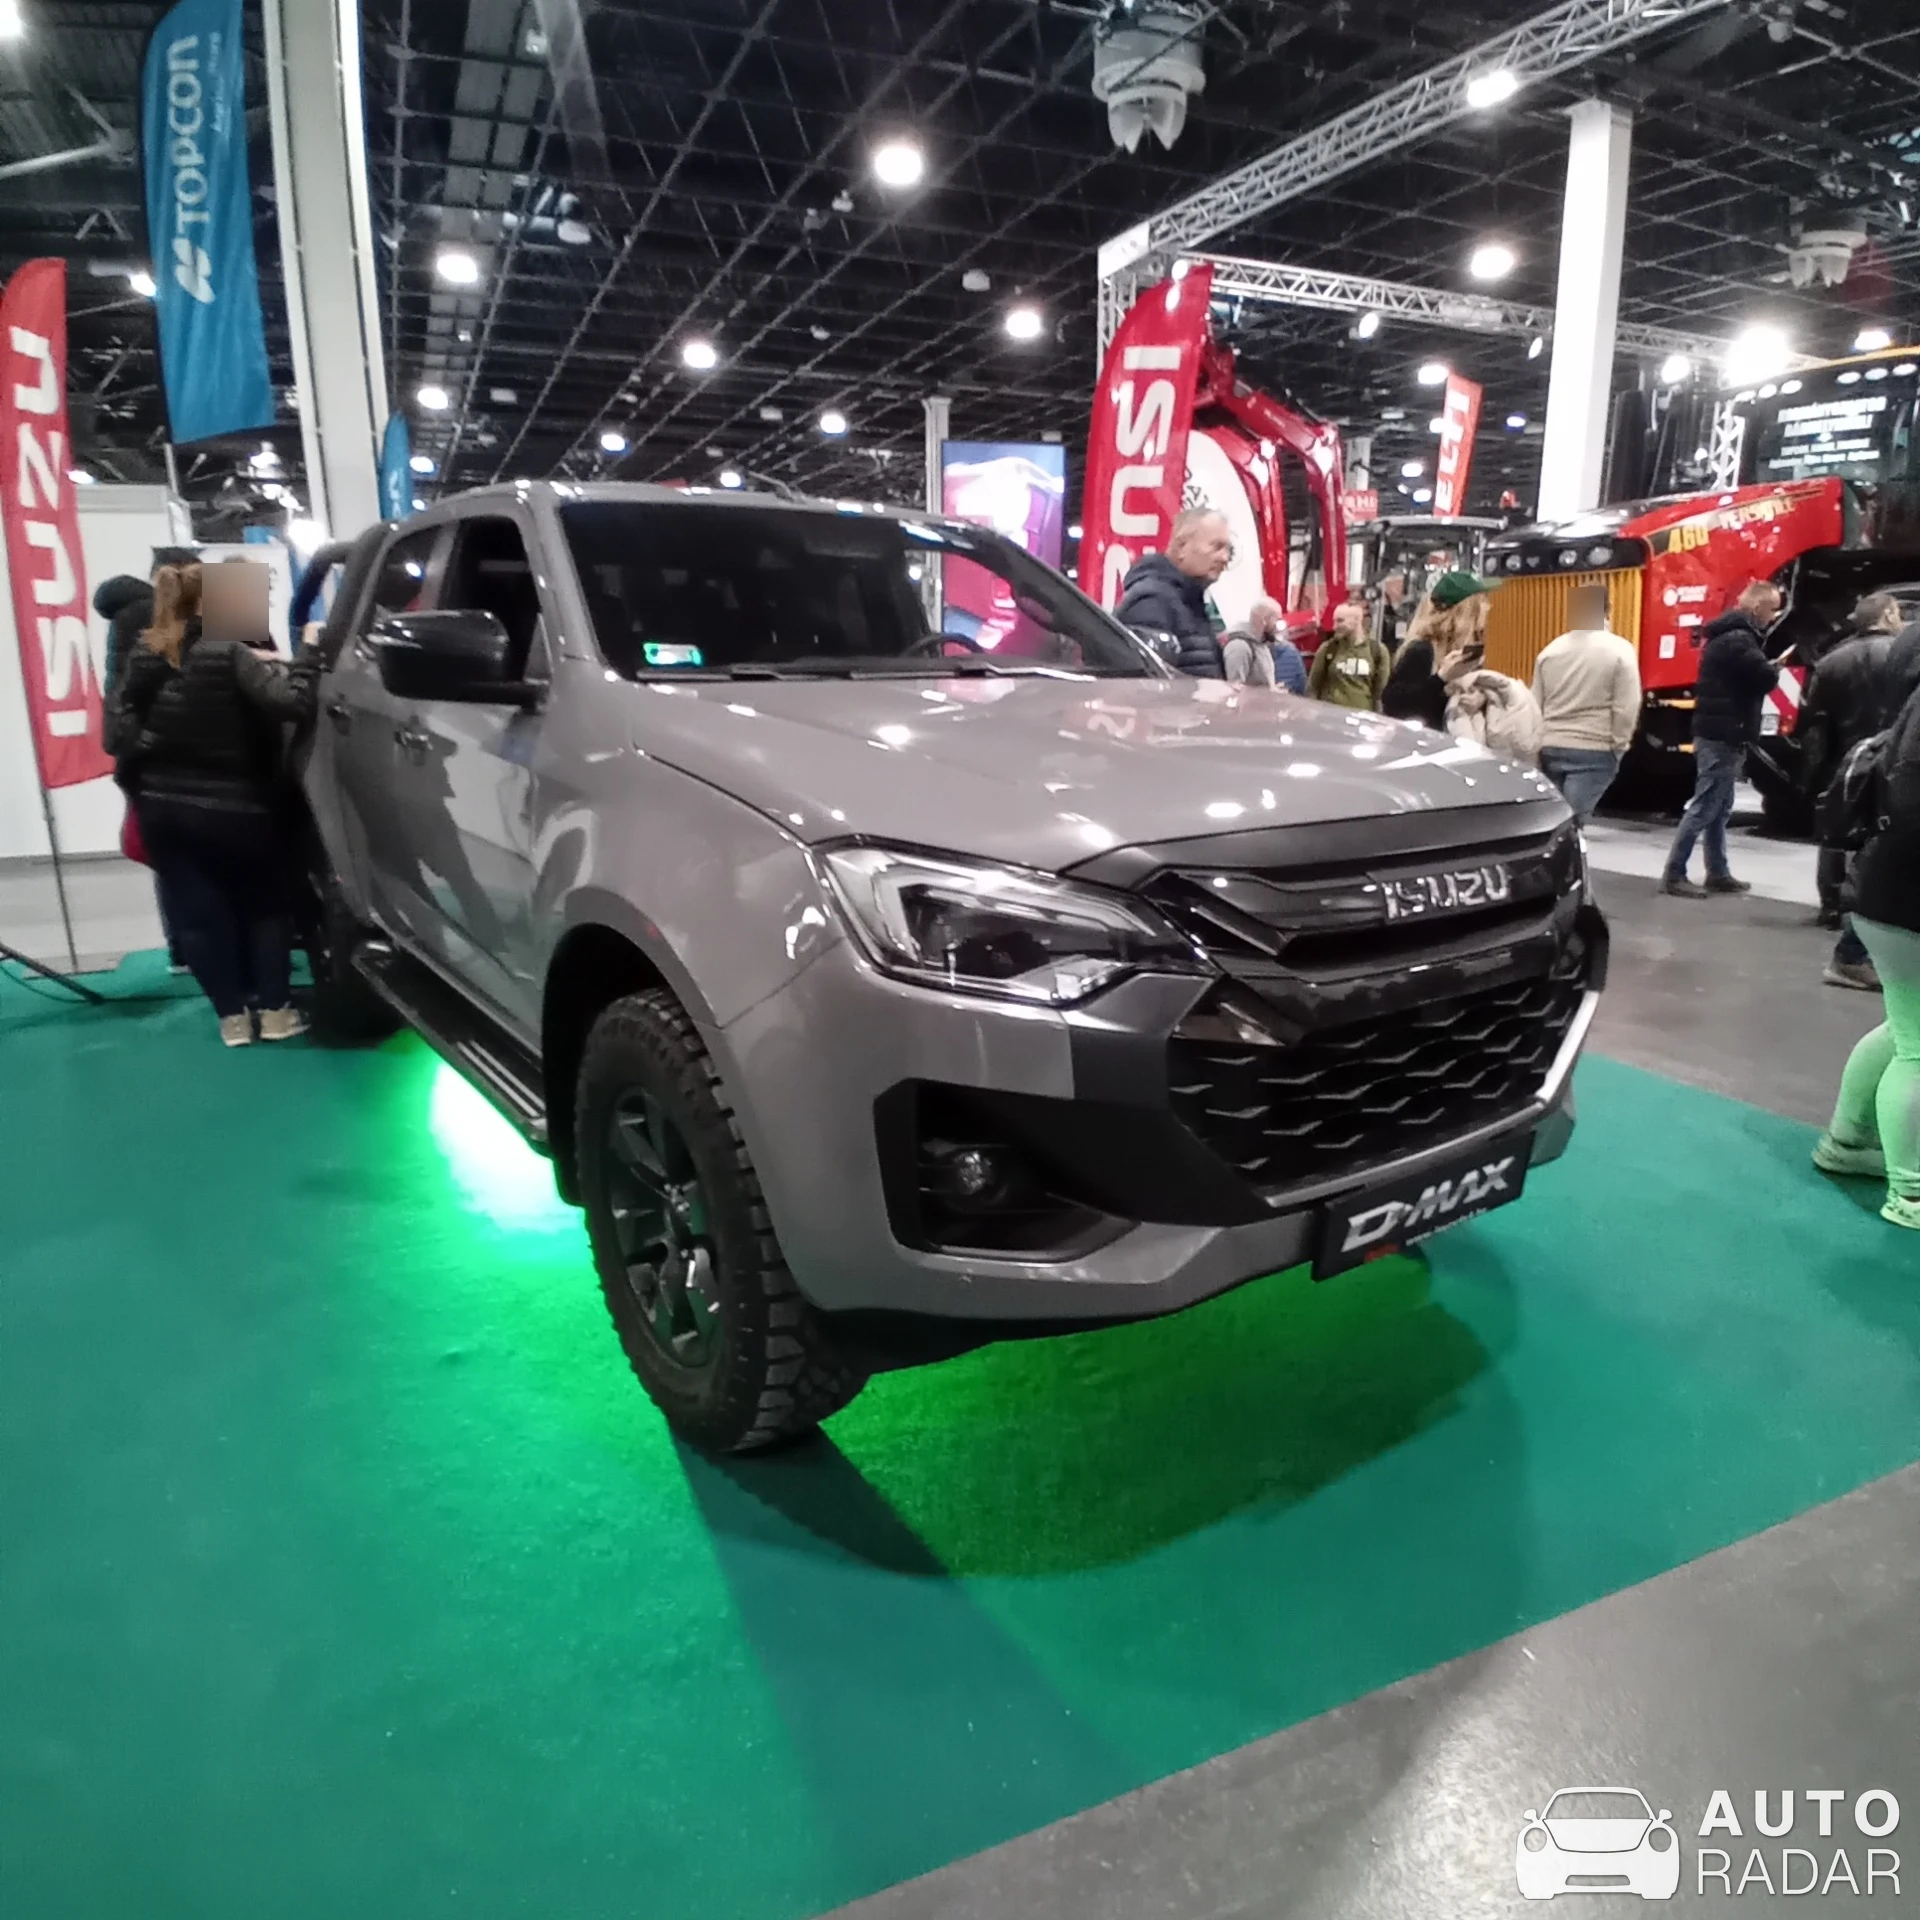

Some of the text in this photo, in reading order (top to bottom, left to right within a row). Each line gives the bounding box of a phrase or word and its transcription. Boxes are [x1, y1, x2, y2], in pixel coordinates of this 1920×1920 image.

[9, 322, 88, 737] ISUZU
[1669, 523, 1710, 554] 460
[1382, 864, 1508, 919] ISUZU
